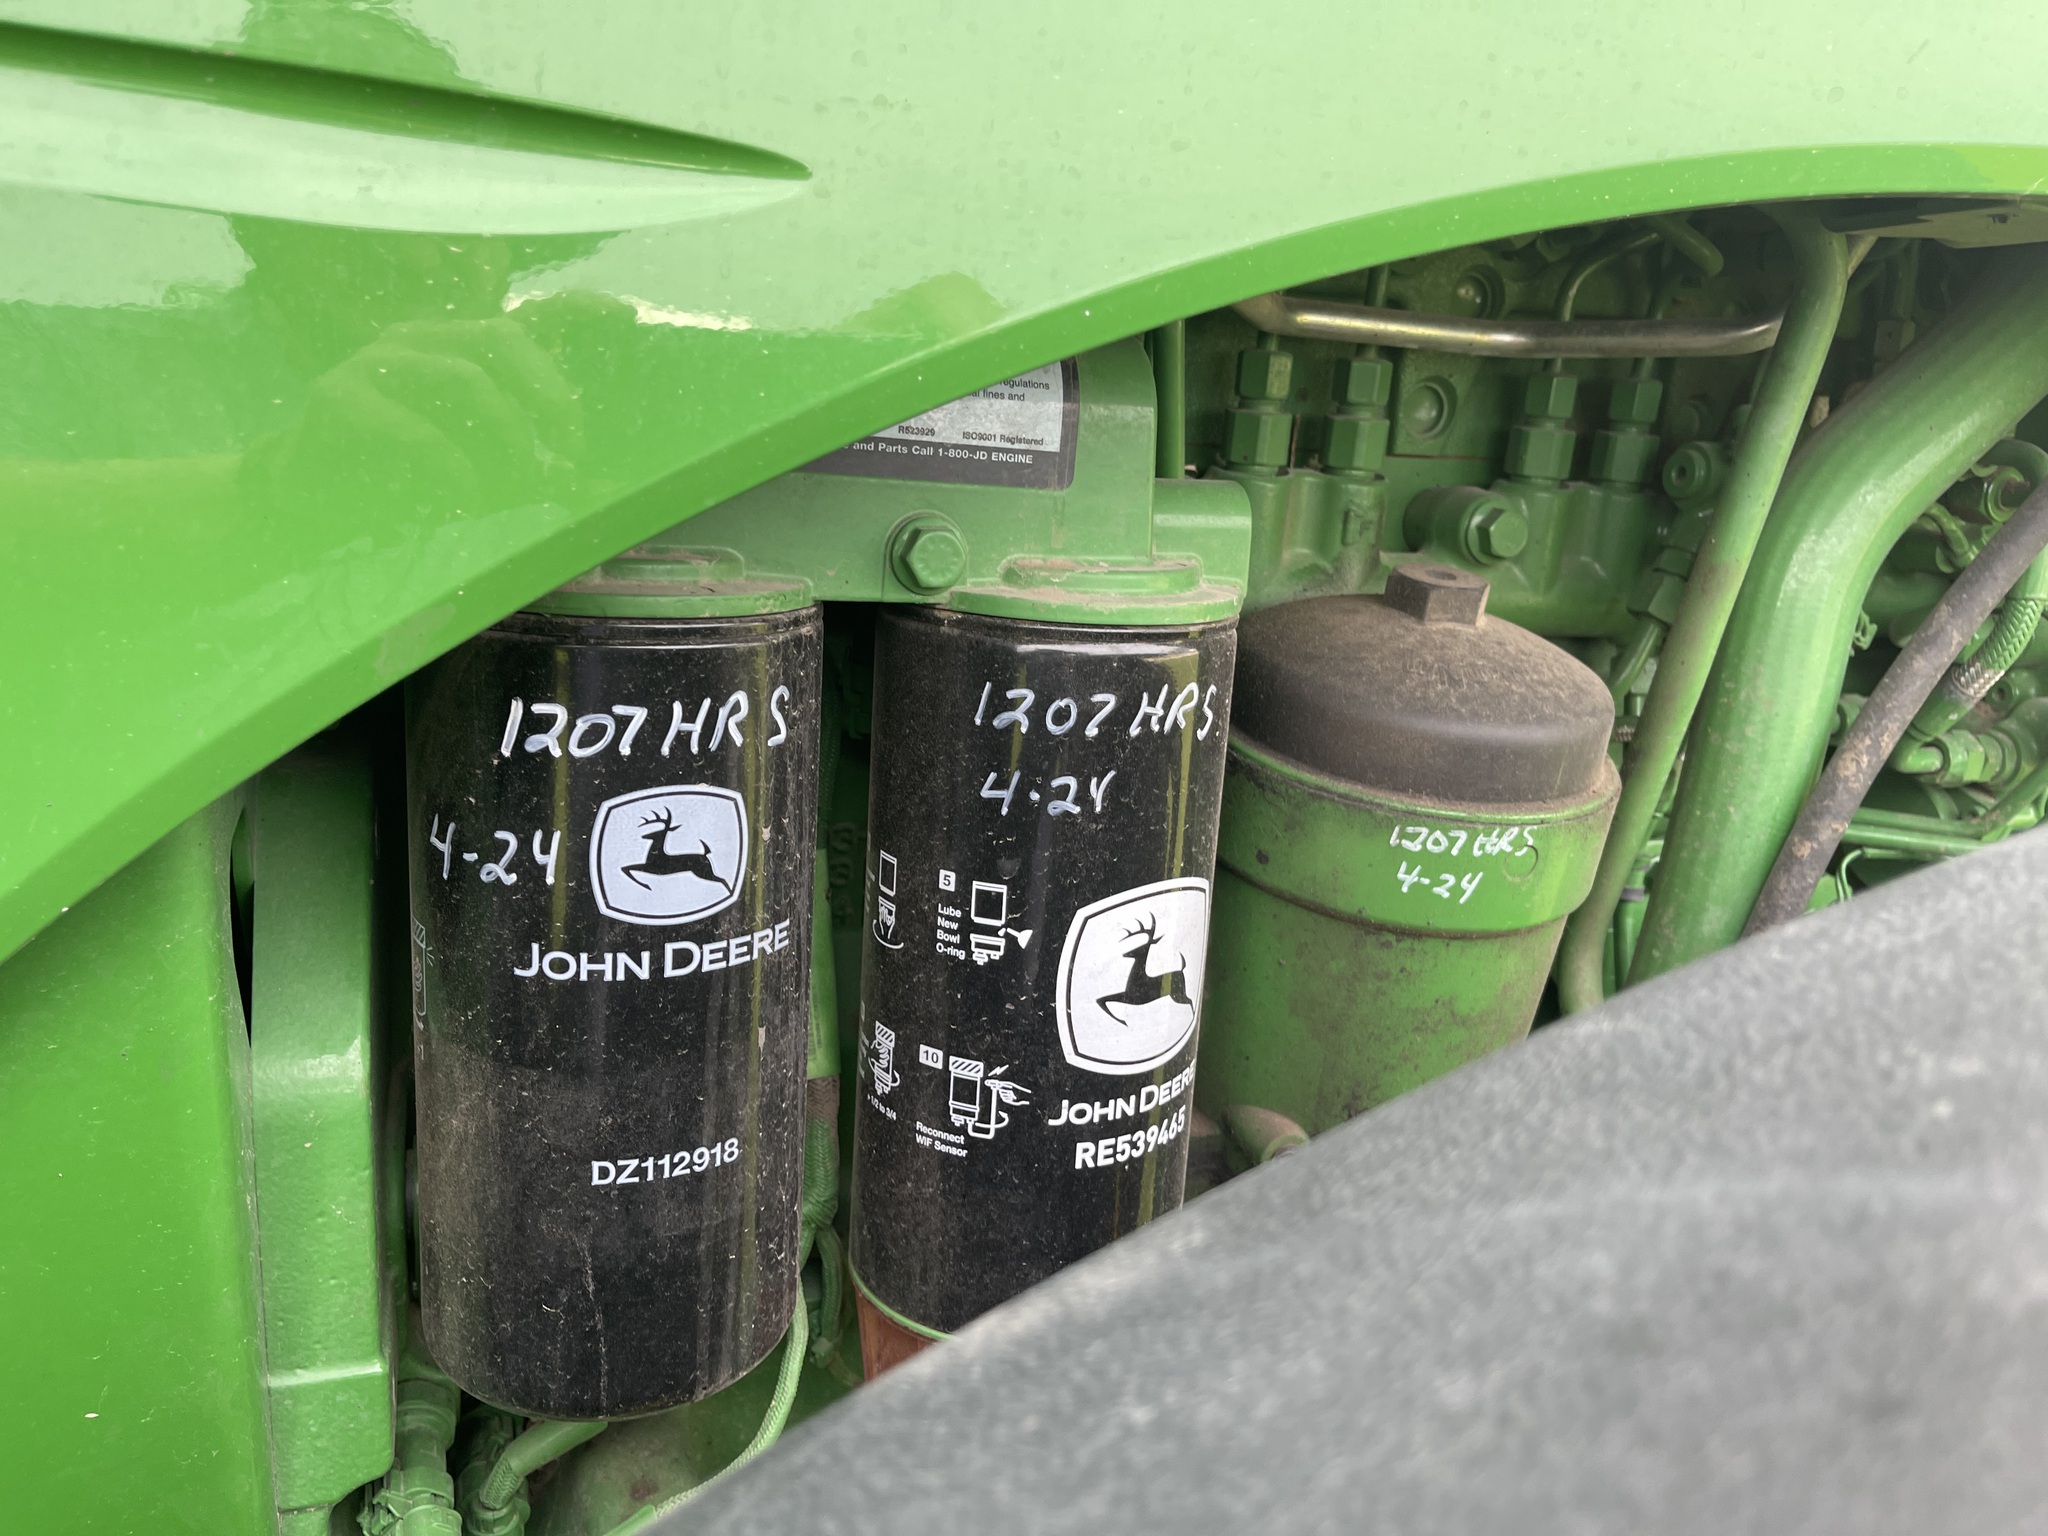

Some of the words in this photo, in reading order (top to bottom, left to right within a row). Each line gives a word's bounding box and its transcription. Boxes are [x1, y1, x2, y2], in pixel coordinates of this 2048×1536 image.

[982, 388, 1005, 400] fines
[1008, 393, 1025, 402] and
[898, 425, 936, 437] R523929
[962, 431, 997, 443] ISO9001
[1000, 434, 1044, 446] Registered
[853, 442, 874, 451] and
[878, 443, 908, 454] Parts
[912, 445, 933, 456] Call
[938, 448, 988, 460] 1-800-JD
[991, 453, 1034, 464] ENGINE
[974, 681, 1117, 738] 1207
[1129, 681, 1218, 741] HRS
[501, 697, 648, 757] 1207
[430, 813, 561, 885] 4-24
[1389, 825, 1467, 857] 1207
[1472, 826, 1537, 857] HRS
[943, 874, 951, 887] 5
[1397, 861, 1483, 904] 4-24
[938, 903, 962, 918] Lube
[937, 916, 959, 930] New
[936, 929, 960, 944] Bowl
[513, 942, 650, 981] JOHN
[663, 918, 790, 978] DEERE
[936, 943, 965, 960] O-ring
[923, 1049, 939, 1064] 10
[1048, 1094, 1136, 1126] JOHN
[1139, 1058, 1195, 1113] DEERE
[886, 1107, 897, 1121] 3/4
[916, 1121, 965, 1145] Reconnect
[1075, 1105, 1186, 1170] RE539465
[915, 1133, 933, 1147] WIF
[934, 1140, 968, 1158] Sensor
[591, 1137, 739, 1186] DZ112918
